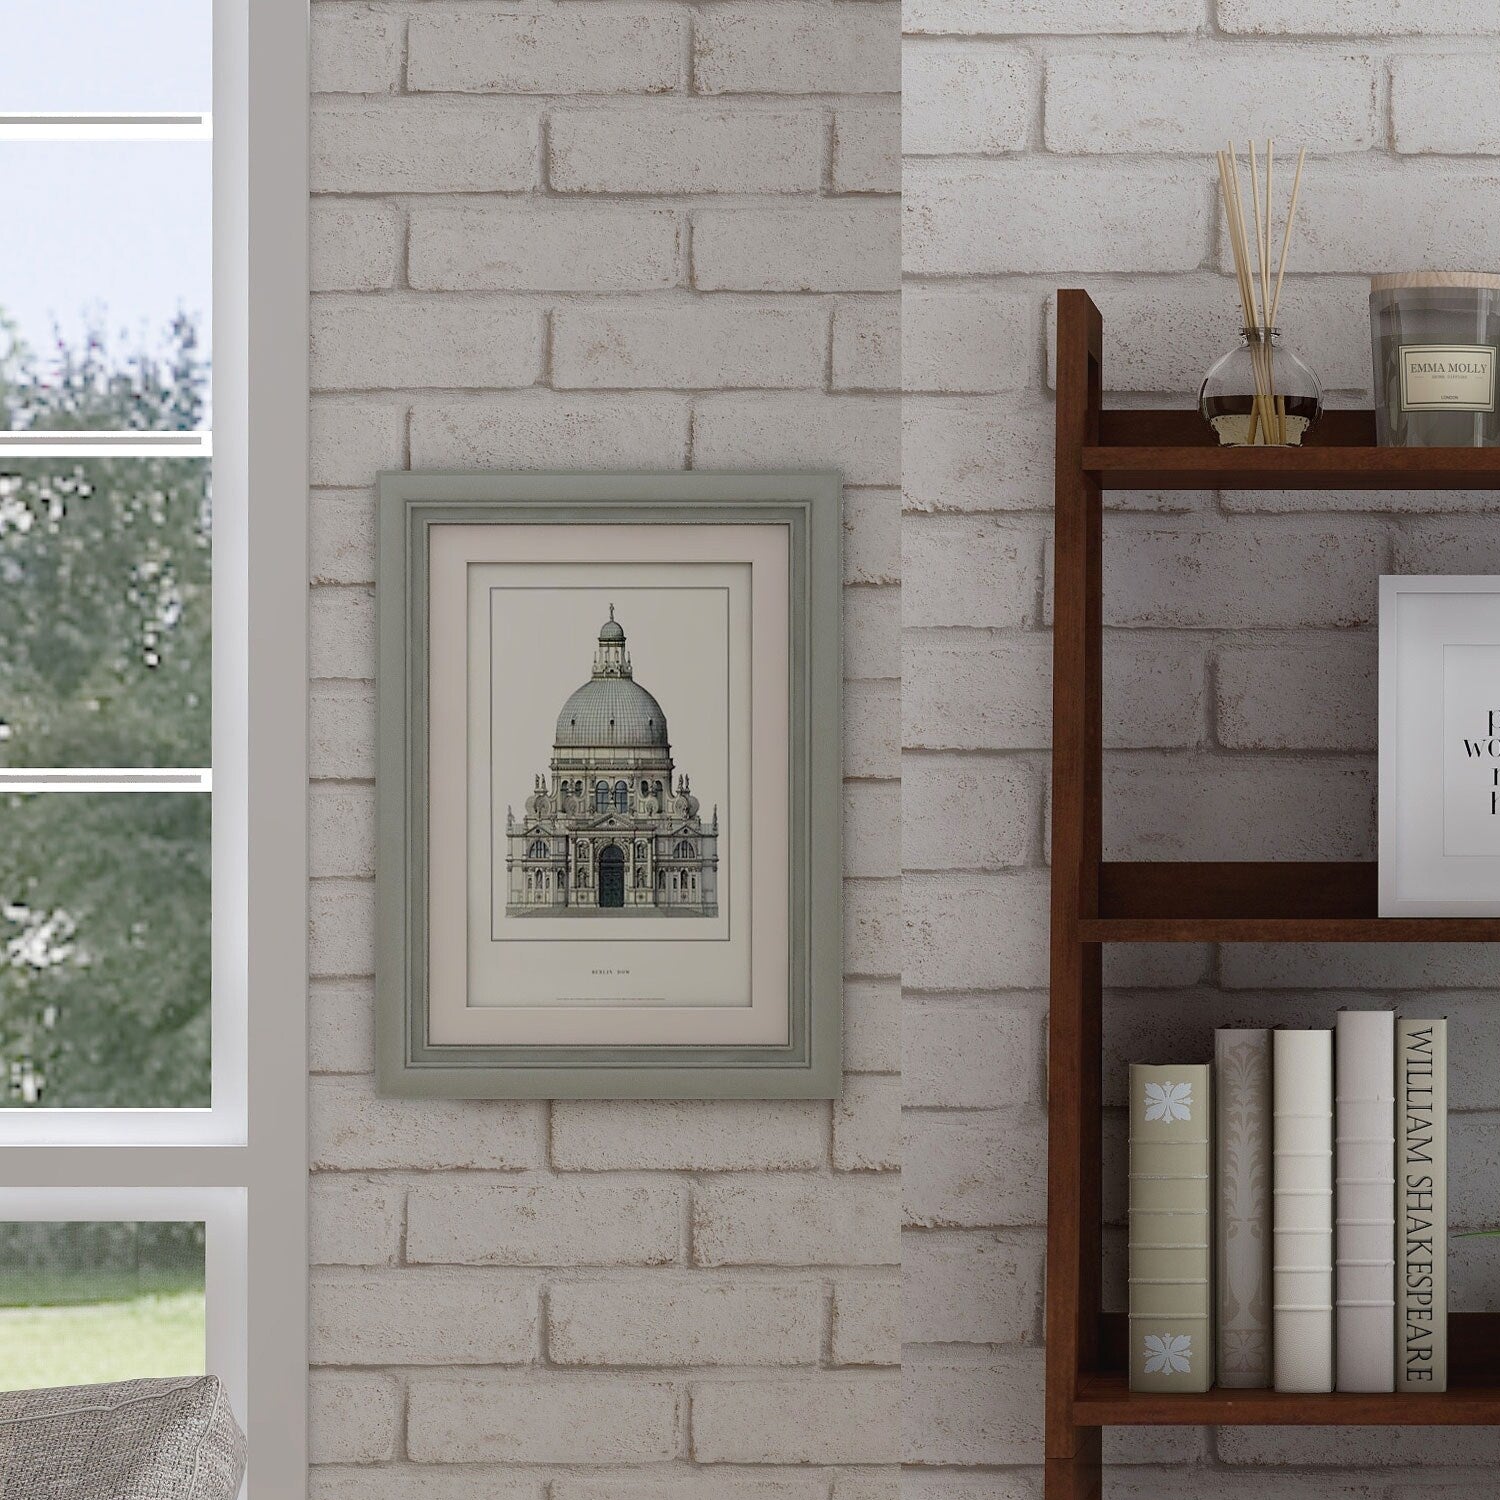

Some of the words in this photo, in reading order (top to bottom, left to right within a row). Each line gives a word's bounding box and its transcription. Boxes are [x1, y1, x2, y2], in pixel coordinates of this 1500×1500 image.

[1410, 363, 1446, 374] EMMA
[1448, 362, 1488, 374] MOLLY
[1404, 1026, 1434, 1165] WILLIAM
[1404, 1174, 1434, 1383] SHAKESPEARE
